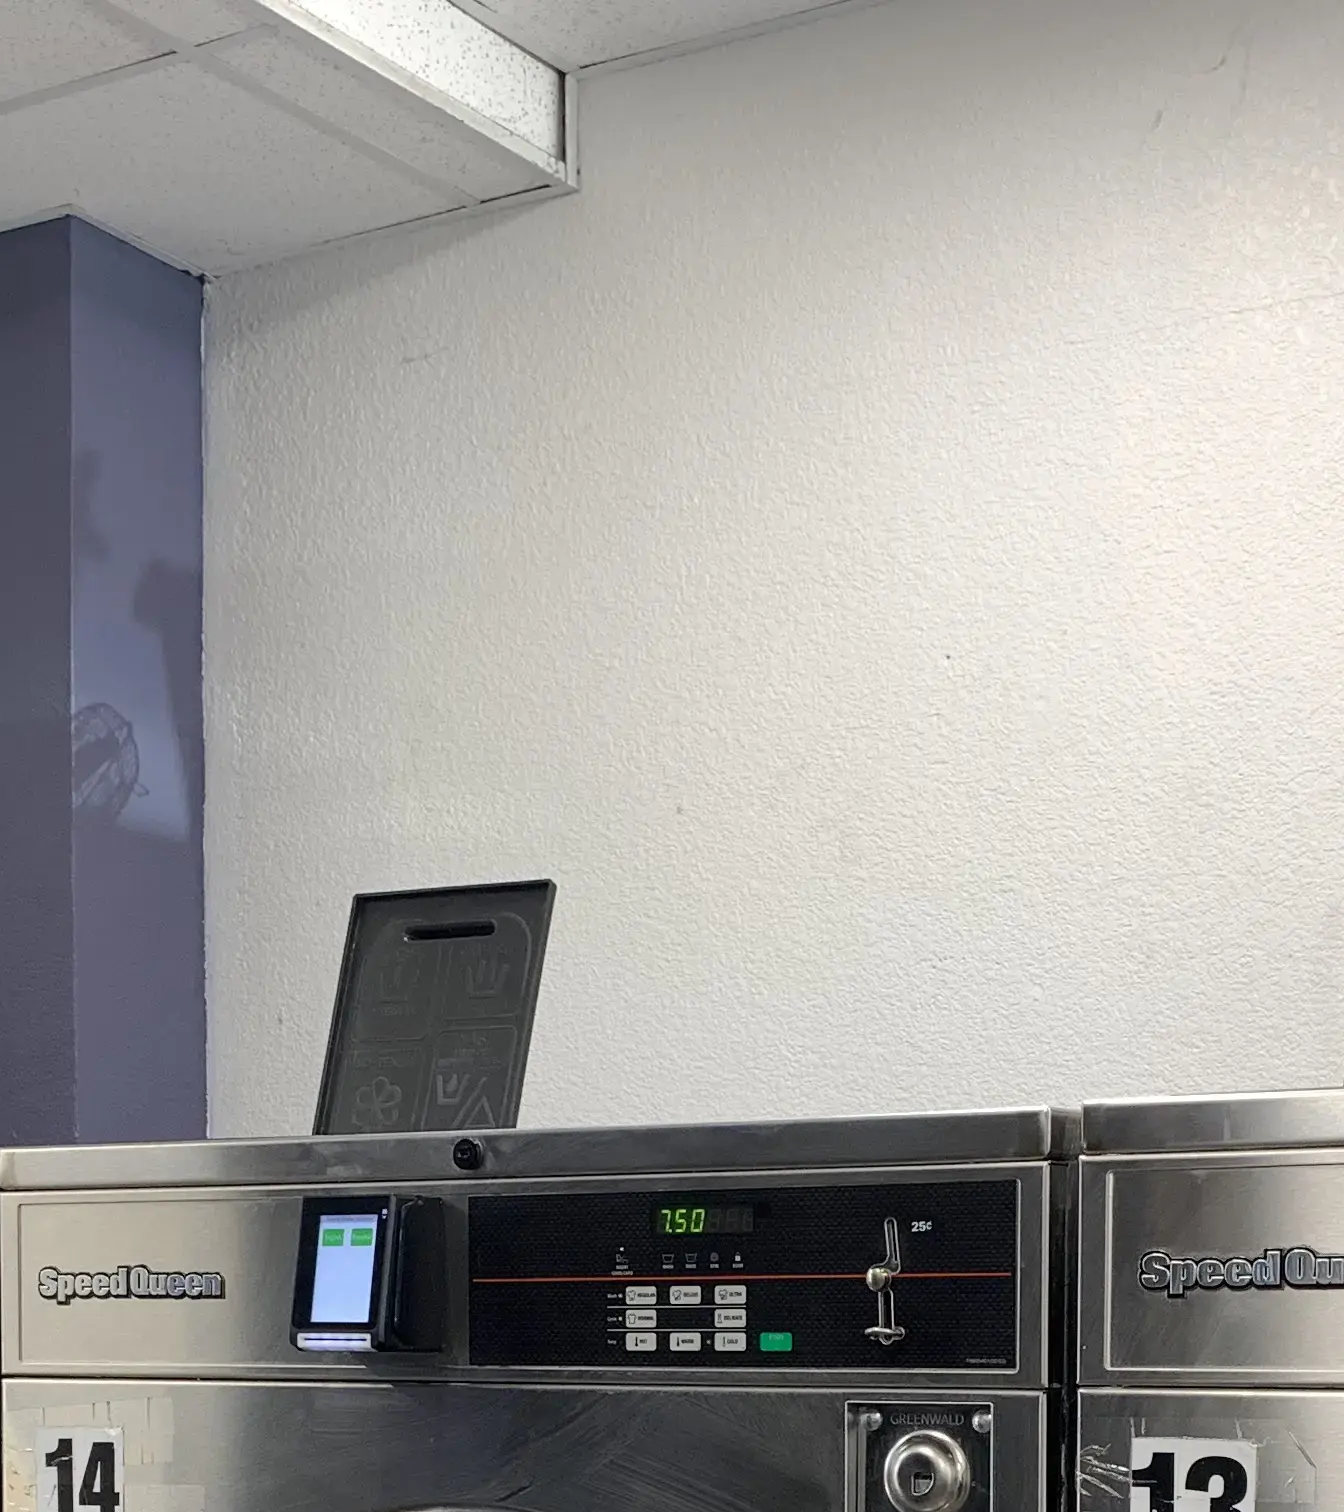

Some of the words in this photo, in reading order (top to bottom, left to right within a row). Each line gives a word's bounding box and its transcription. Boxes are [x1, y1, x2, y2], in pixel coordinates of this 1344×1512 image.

[660, 1208, 706, 1233] 7.50
[38, 1266, 129, 1304] Speed
[130, 1265, 225, 1299] Queen
[1139, 1250, 1282, 1298] Speed
[890, 1413, 965, 1426] GREENWALD
